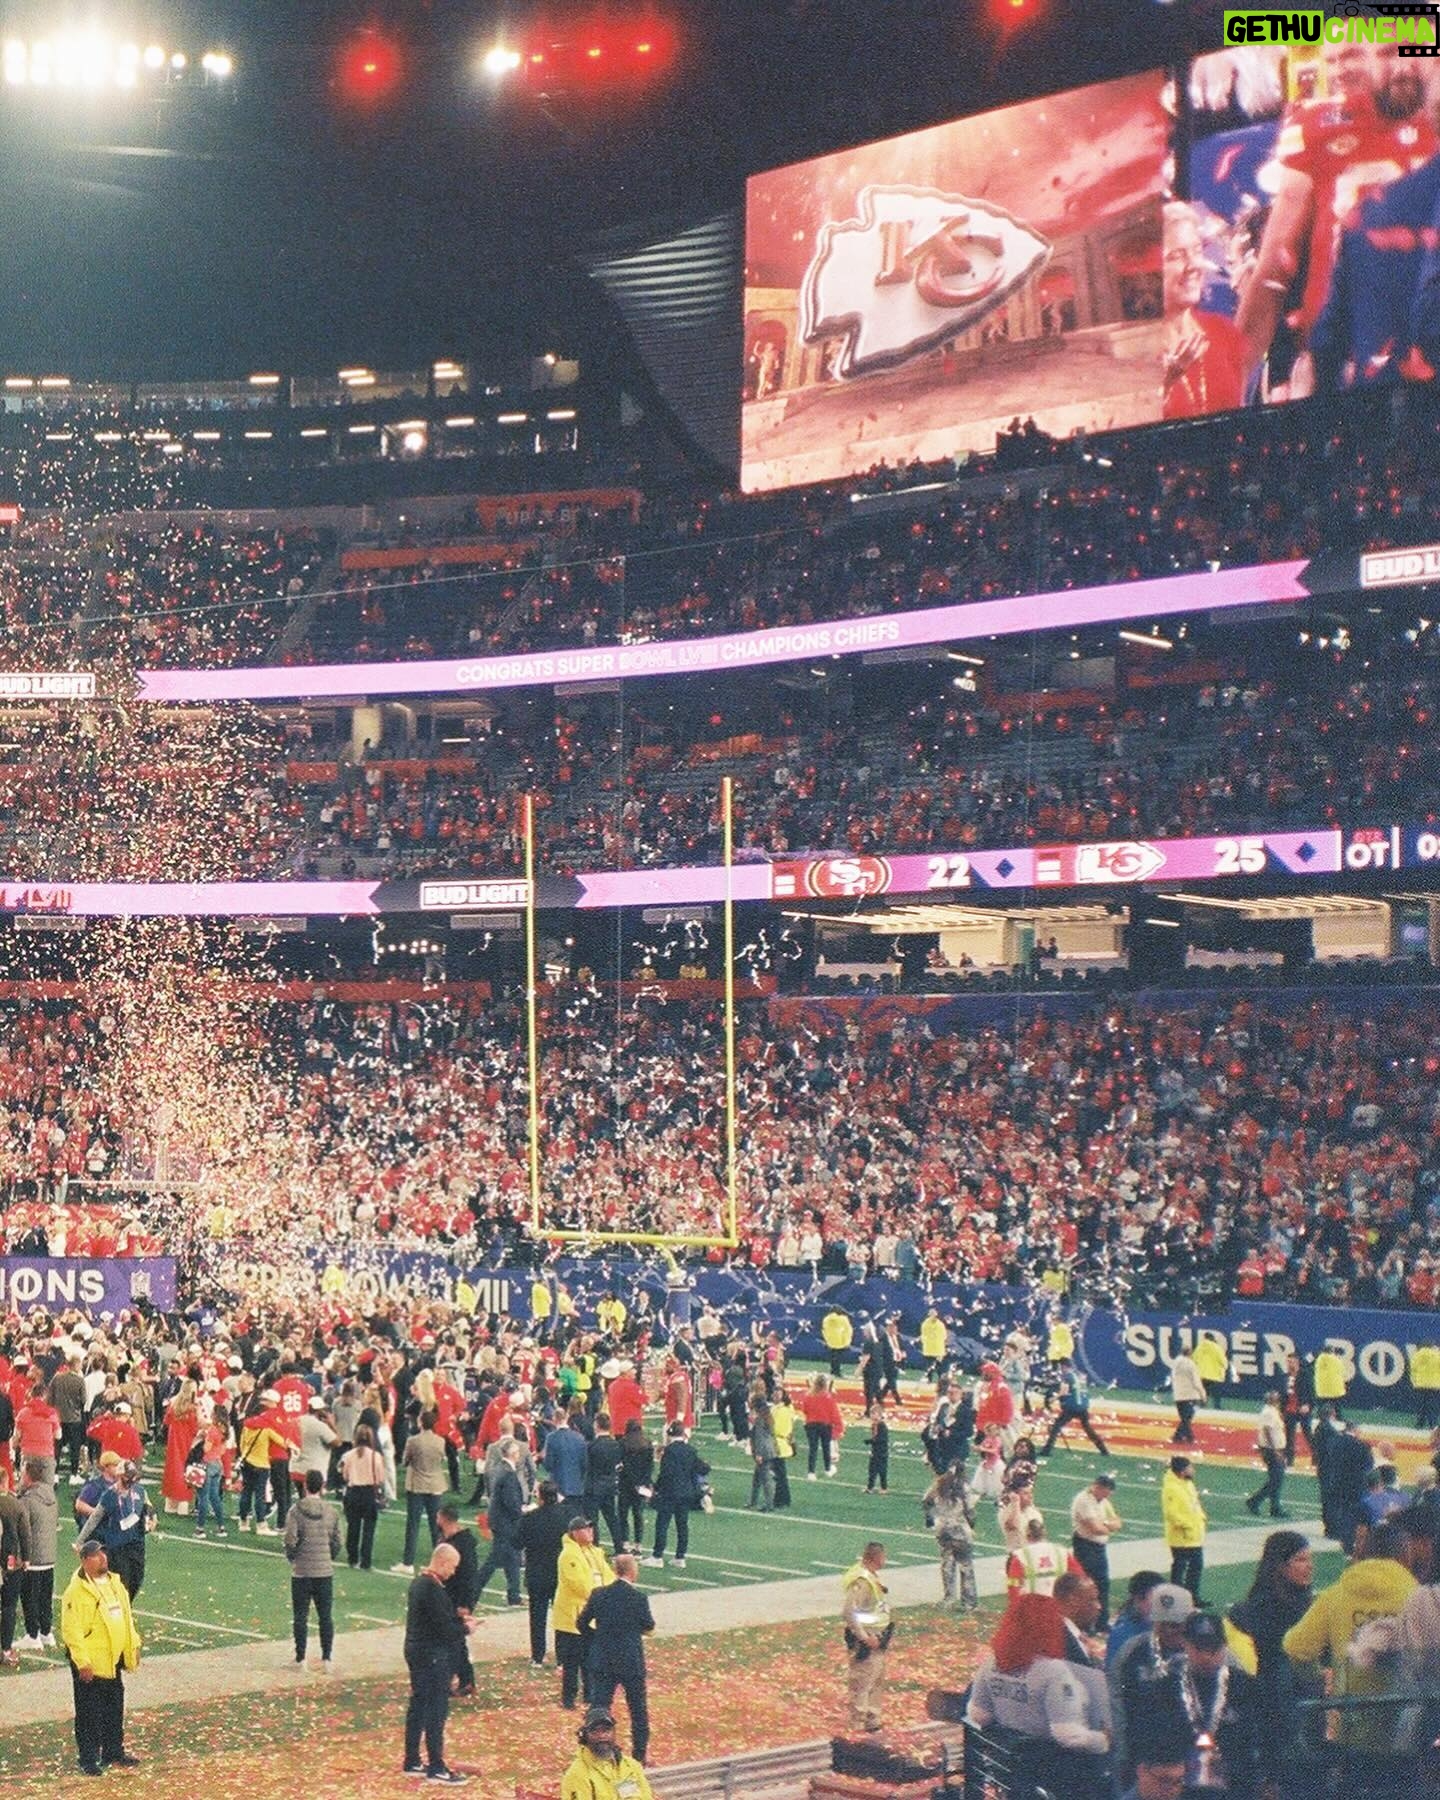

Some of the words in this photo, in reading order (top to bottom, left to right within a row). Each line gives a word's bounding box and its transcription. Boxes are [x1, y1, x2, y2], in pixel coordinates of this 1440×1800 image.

[1367, 555, 1423, 580] BUD
[456, 659, 553, 684] CONGRATS
[557, 654, 615, 676] SUPER
[619, 647, 676, 670] BOWL
[721, 630, 831, 661] CHAMPIONS
[835, 621, 900, 647] CHIEFS
[32, 678, 91, 694] LIGHT
[1214, 839, 1267, 873] 25
[1345, 841, 1390, 868] OT
[926, 855, 971, 889] 22
[424, 886, 468, 905] BUD
